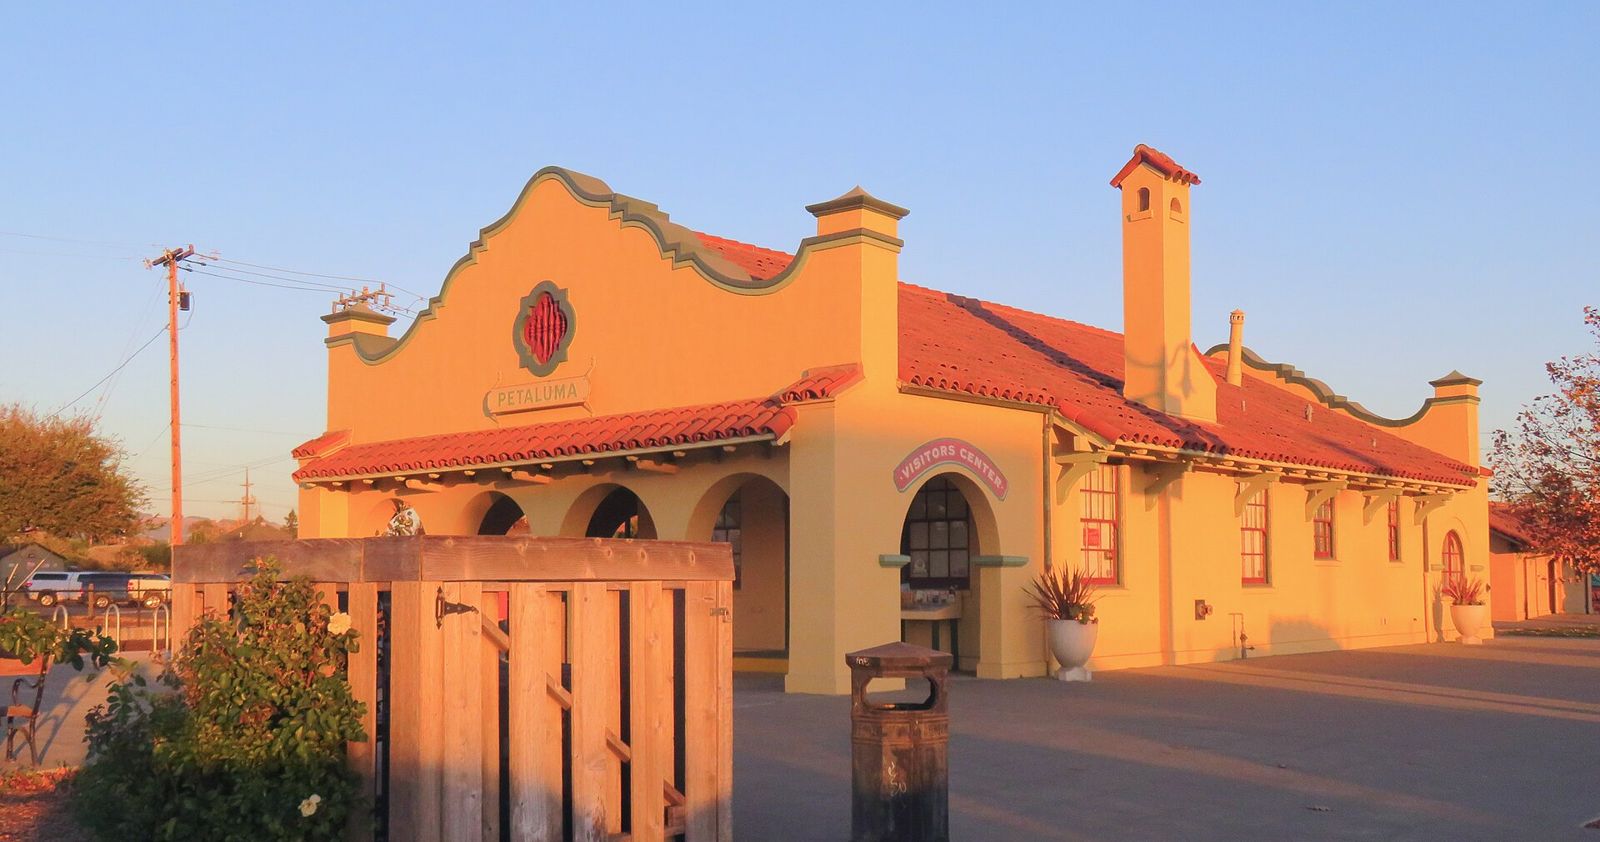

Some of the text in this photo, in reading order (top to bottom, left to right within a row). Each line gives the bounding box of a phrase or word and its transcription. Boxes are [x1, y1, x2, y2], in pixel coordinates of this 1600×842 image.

[498, 383, 578, 407] PETALUMA
[901, 445, 1003, 489] VISITORS CENTER
